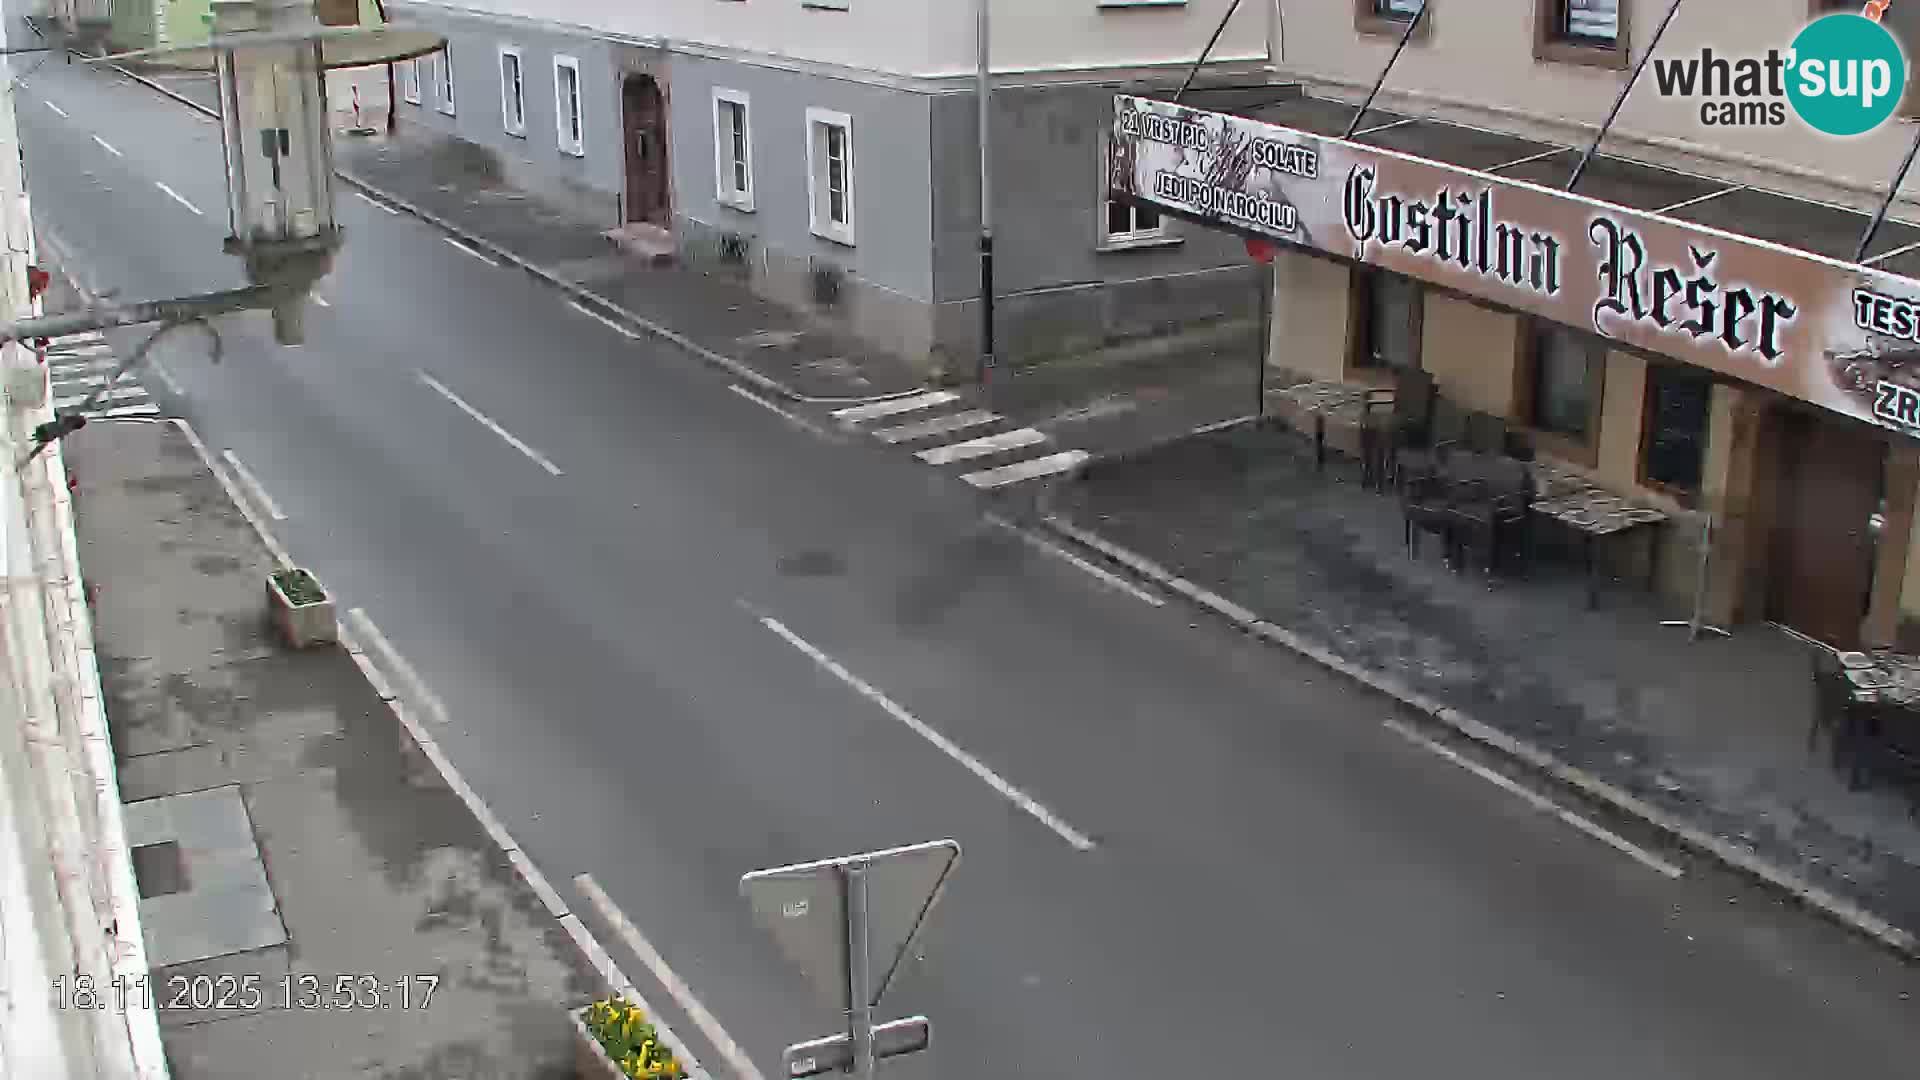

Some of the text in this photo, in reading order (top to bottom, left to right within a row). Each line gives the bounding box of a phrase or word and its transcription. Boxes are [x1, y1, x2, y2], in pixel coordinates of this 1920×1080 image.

[1253, 140, 1317, 177] SOLATE
[1343, 163, 1796, 361] Gostilna Rešer
[1876, 382, 1920, 425] ZR
